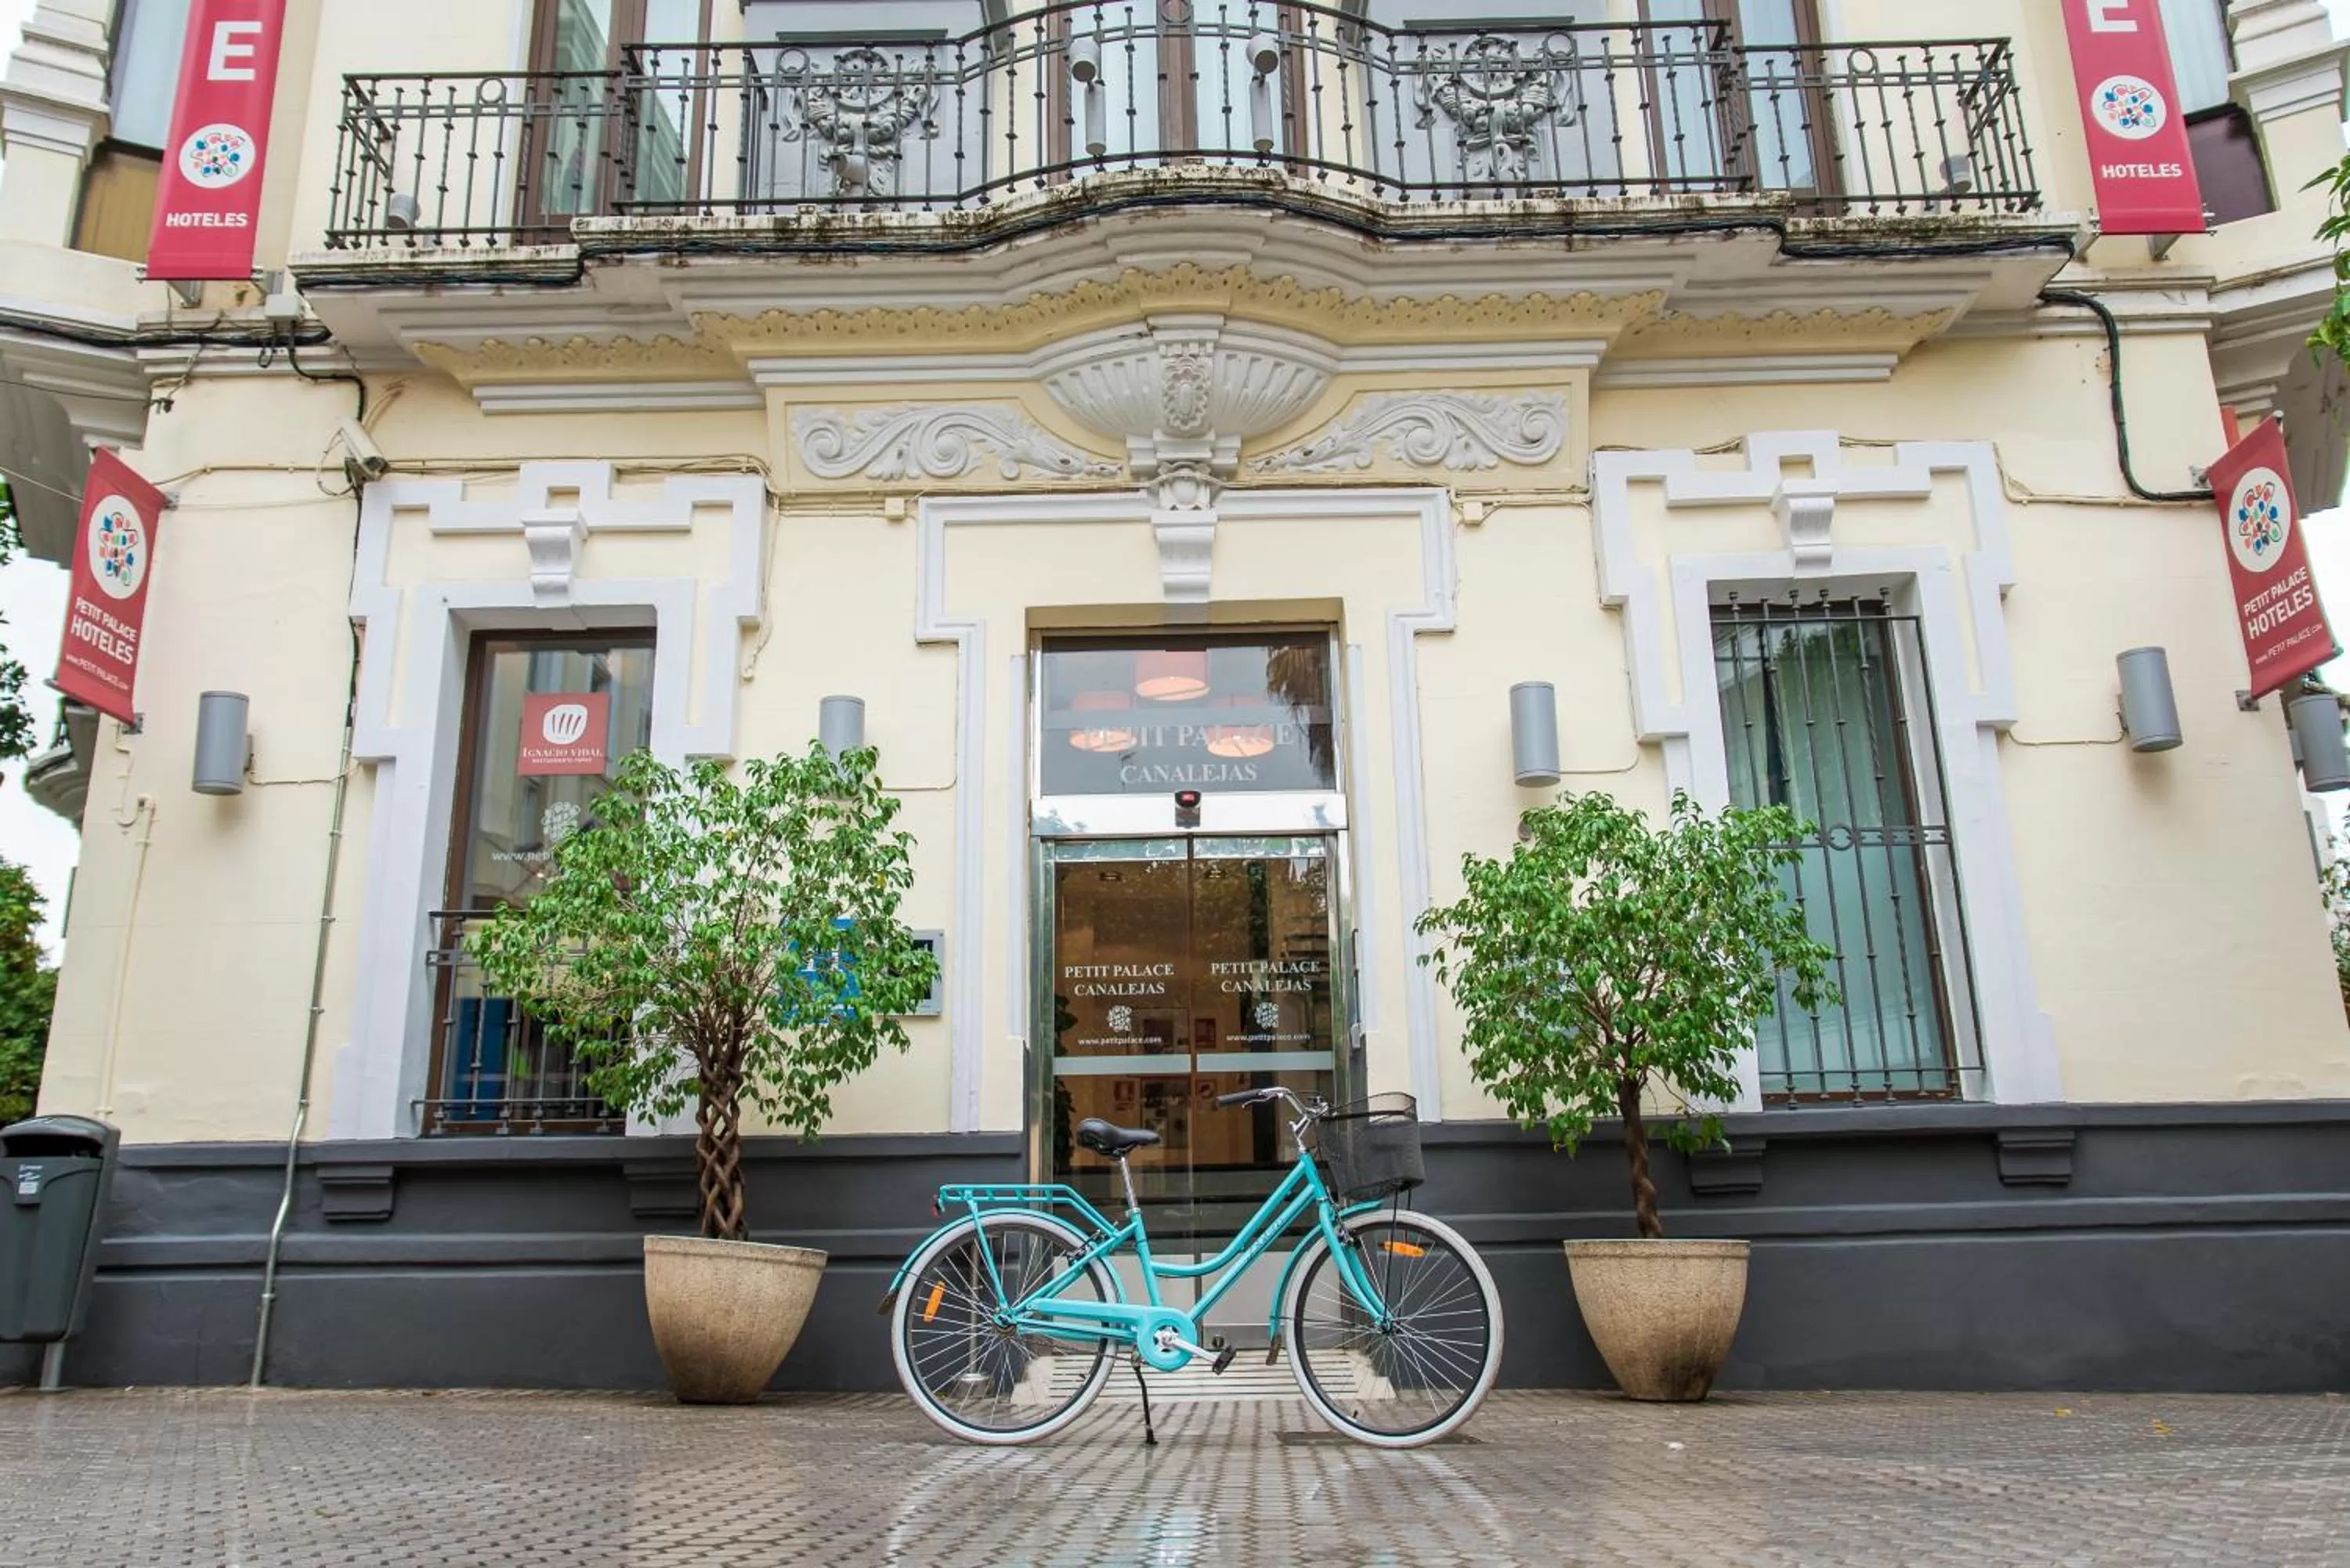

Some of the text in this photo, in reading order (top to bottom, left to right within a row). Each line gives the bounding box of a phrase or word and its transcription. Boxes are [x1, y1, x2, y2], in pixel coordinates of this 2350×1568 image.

[207, 21, 262, 81] E
[2102, 164, 2182, 179] HOTELES
[165, 212, 248, 227] HOTELES
[2243, 566, 2308, 617] PETIT PALACE
[74, 596, 137, 643] PETIT PALACE
[2247, 584, 2313, 640] HOTELES
[70, 614, 134, 665] HOTELES
[1177, 724, 1294, 747] PALACE
[1119, 764, 1257, 784] CANALEJAS
[1065, 963, 1174, 978] PETIT PALACE
[1210, 960, 1321, 975] PETIT PALACE
[1073, 981, 1166, 997] CANALEJAS
[1220, 978, 1313, 993] CANALEJAS
[1077, 1035, 1162, 1046] www.petitpalace.com
